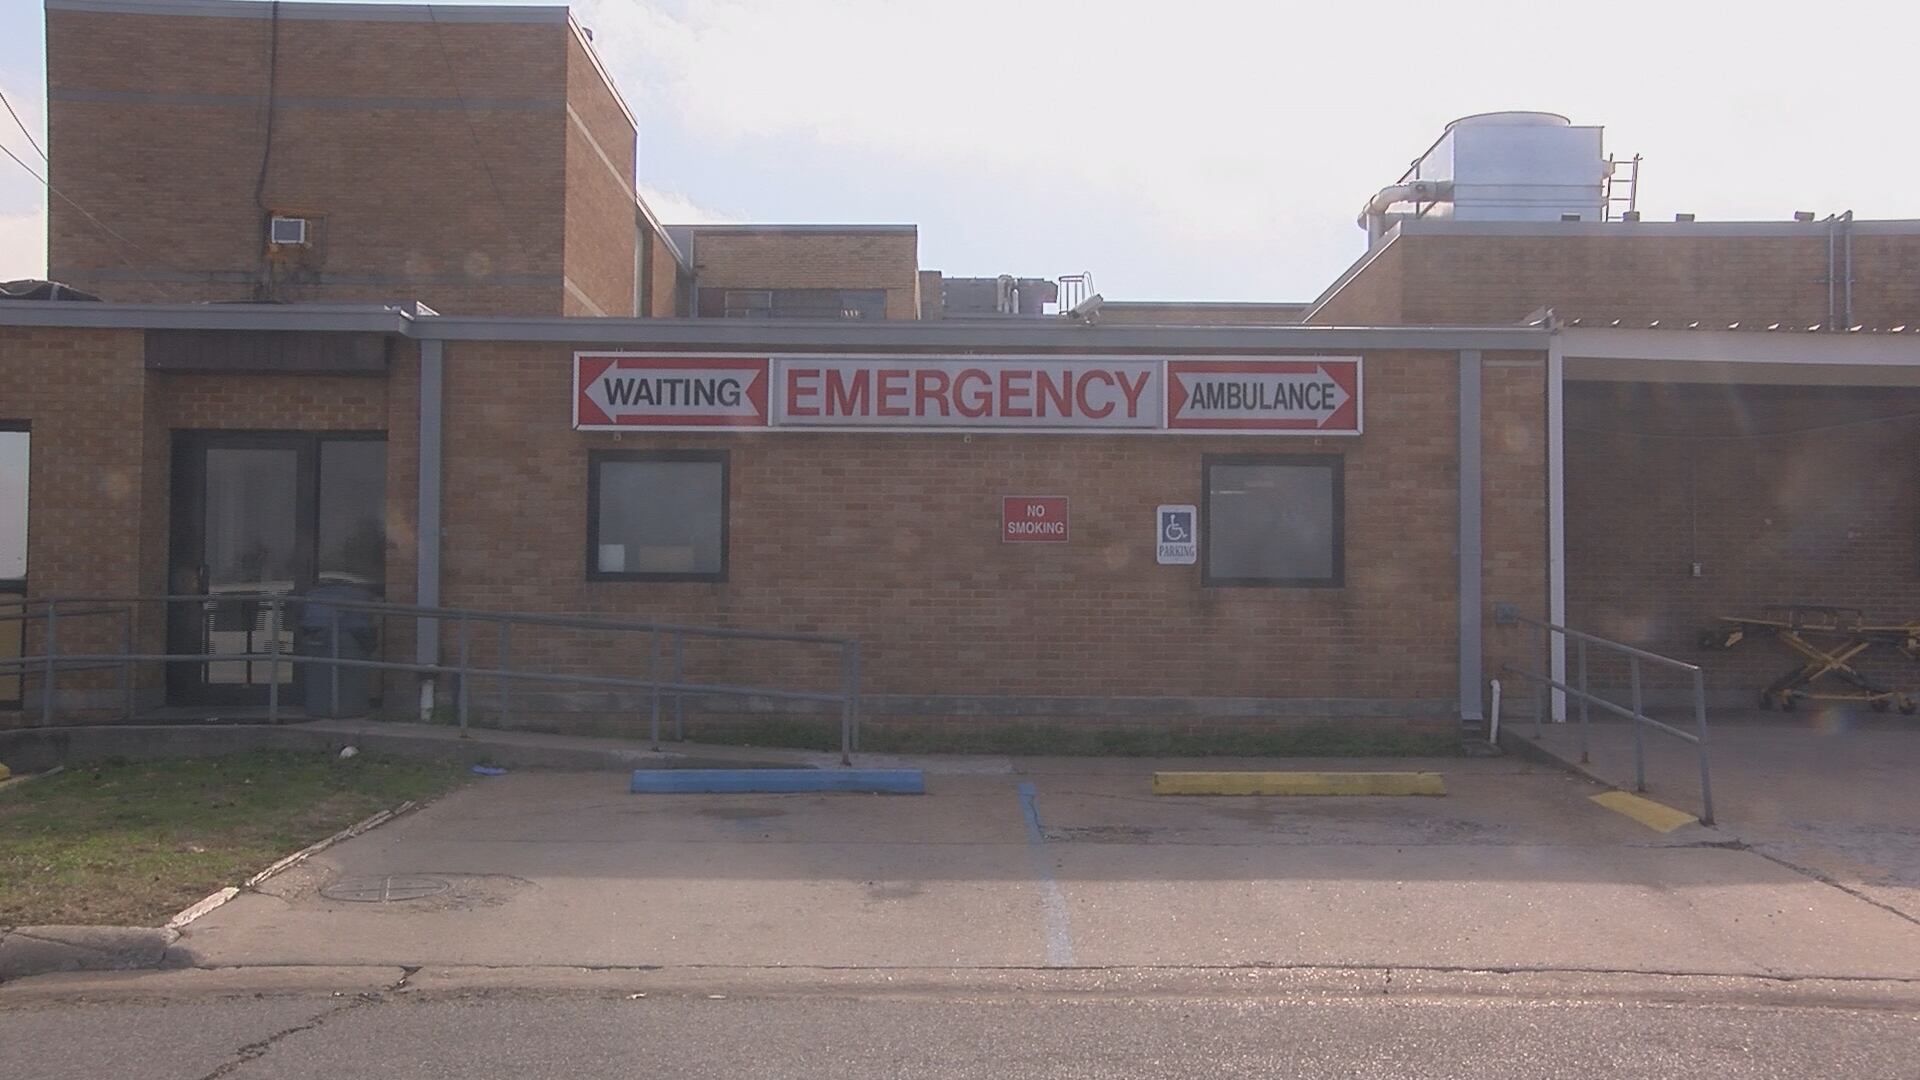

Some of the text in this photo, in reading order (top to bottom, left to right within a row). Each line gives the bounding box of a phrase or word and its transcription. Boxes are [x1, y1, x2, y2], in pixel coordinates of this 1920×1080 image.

[604, 378, 741, 407] WAITING
[787, 368, 1151, 419] EMERGENCY
[1190, 382, 1336, 411] AMBULANCE
[1027, 504, 1045, 517] NO
[1007, 521, 1065, 535] SMOKING
[1159, 545, 1196, 557] PARKING
